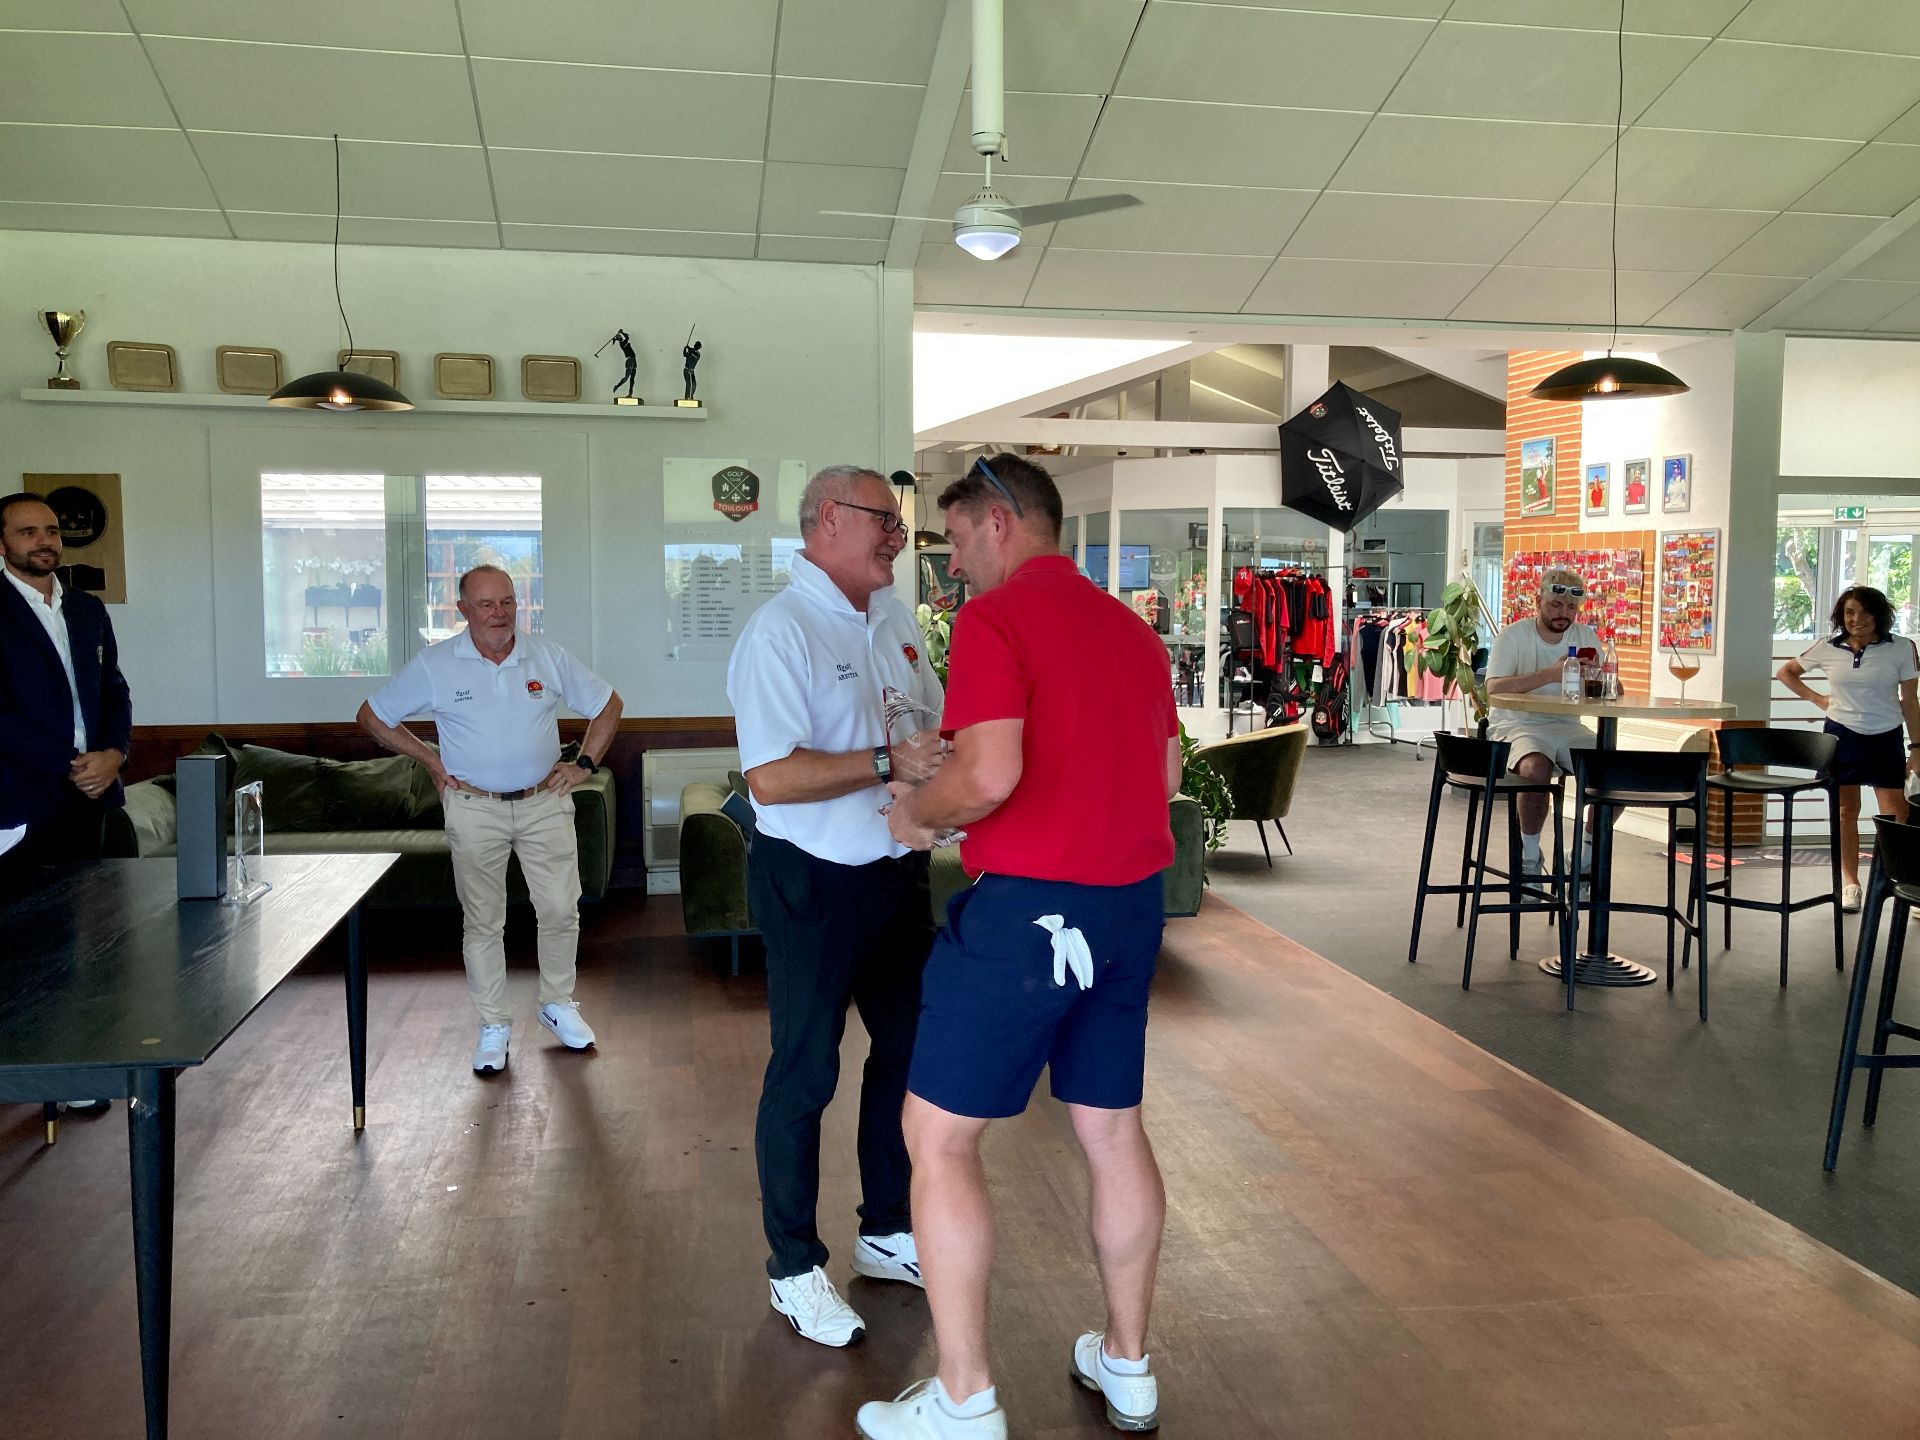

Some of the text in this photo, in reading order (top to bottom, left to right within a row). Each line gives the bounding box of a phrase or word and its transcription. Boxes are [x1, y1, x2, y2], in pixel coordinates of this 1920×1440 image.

[1356, 407, 1399, 471] Titleist
[718, 503, 753, 512] TOULOUSE
[1307, 448, 1352, 511] Titleist
